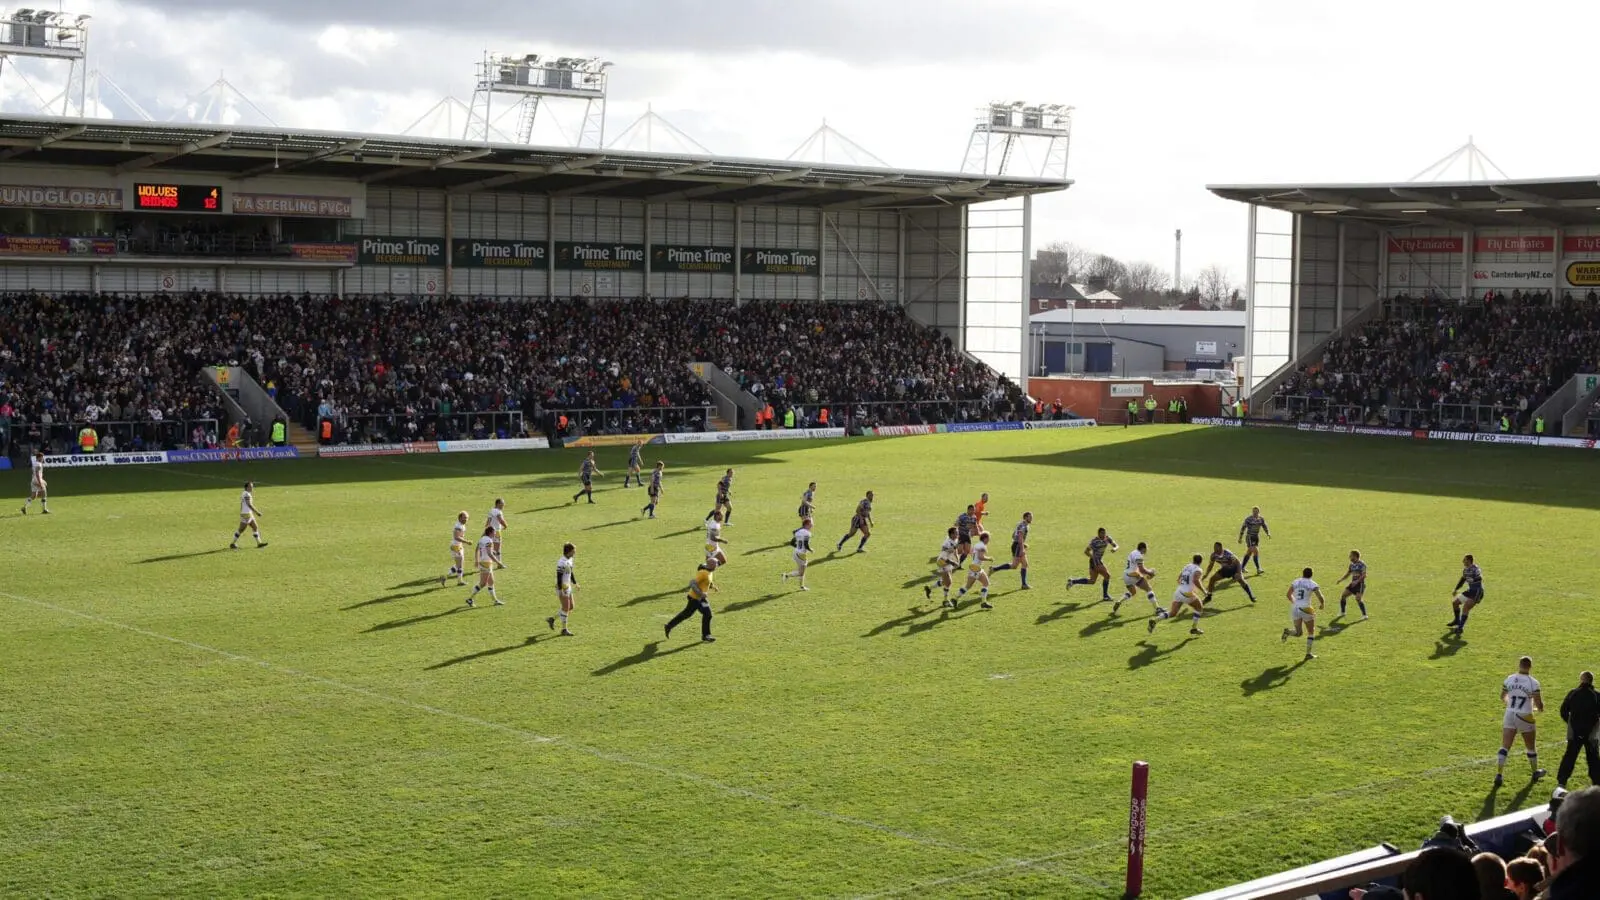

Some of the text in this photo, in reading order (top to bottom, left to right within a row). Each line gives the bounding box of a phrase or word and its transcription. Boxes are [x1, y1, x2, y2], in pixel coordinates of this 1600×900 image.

[0, 187, 121, 206] UNDGLOBAL
[138, 185, 218, 197] WOLVES 4
[204, 197, 217, 208] 12
[255, 198, 317, 212] STERLING
[363, 239, 404, 254] Prime
[407, 240, 440, 255] Time
[472, 243, 545, 258] Prime Time
[1416, 240, 1456, 249] Emirates
[1488, 239, 1545, 250] Fly Emirates
[1577, 239, 1593, 250] Fly
[573, 245, 643, 261] Prime Time
[668, 248, 731, 263] Prime Time
[756, 250, 816, 266] Prime Time
[1428, 430, 1475, 441] CANTERBURY
[1477, 433, 1496, 441] arco
[1298, 589, 1305, 600] 3
[1511, 696, 1526, 709] 17
